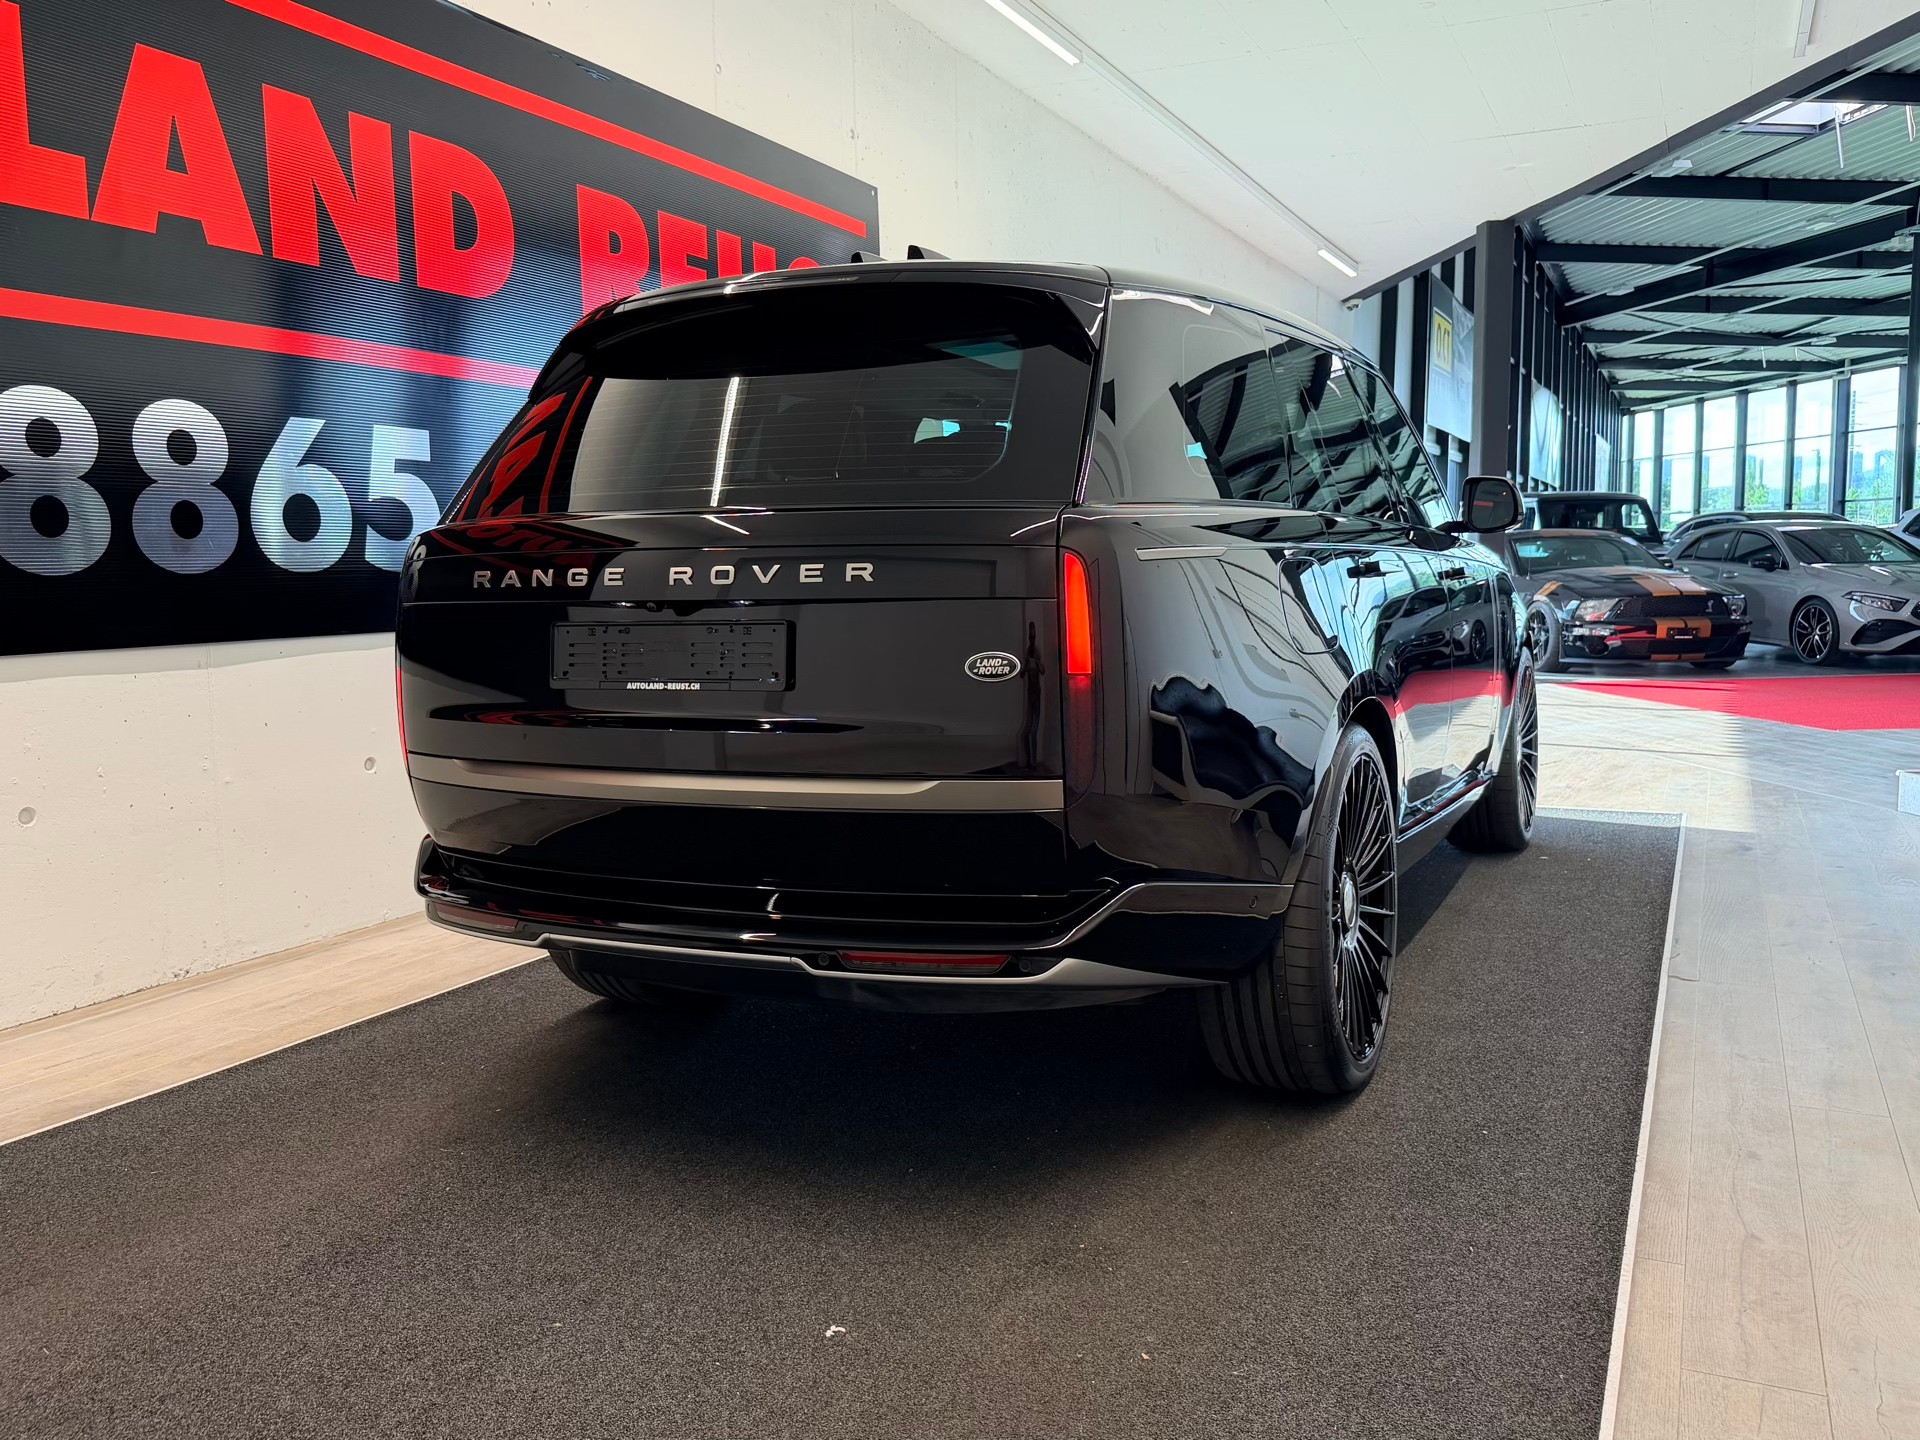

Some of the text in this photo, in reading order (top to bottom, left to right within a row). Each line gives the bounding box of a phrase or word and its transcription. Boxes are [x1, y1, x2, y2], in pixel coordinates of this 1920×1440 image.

[0, 0, 821, 317] LAND RE
[0, 385, 441, 576] 8865
[473, 562, 875, 588] RANGE ROVER
[976, 658, 1002, 666] LAND
[978, 666, 1010, 674] ROVER
[626, 682, 701, 690] AUTOLAND-REUST.CH
